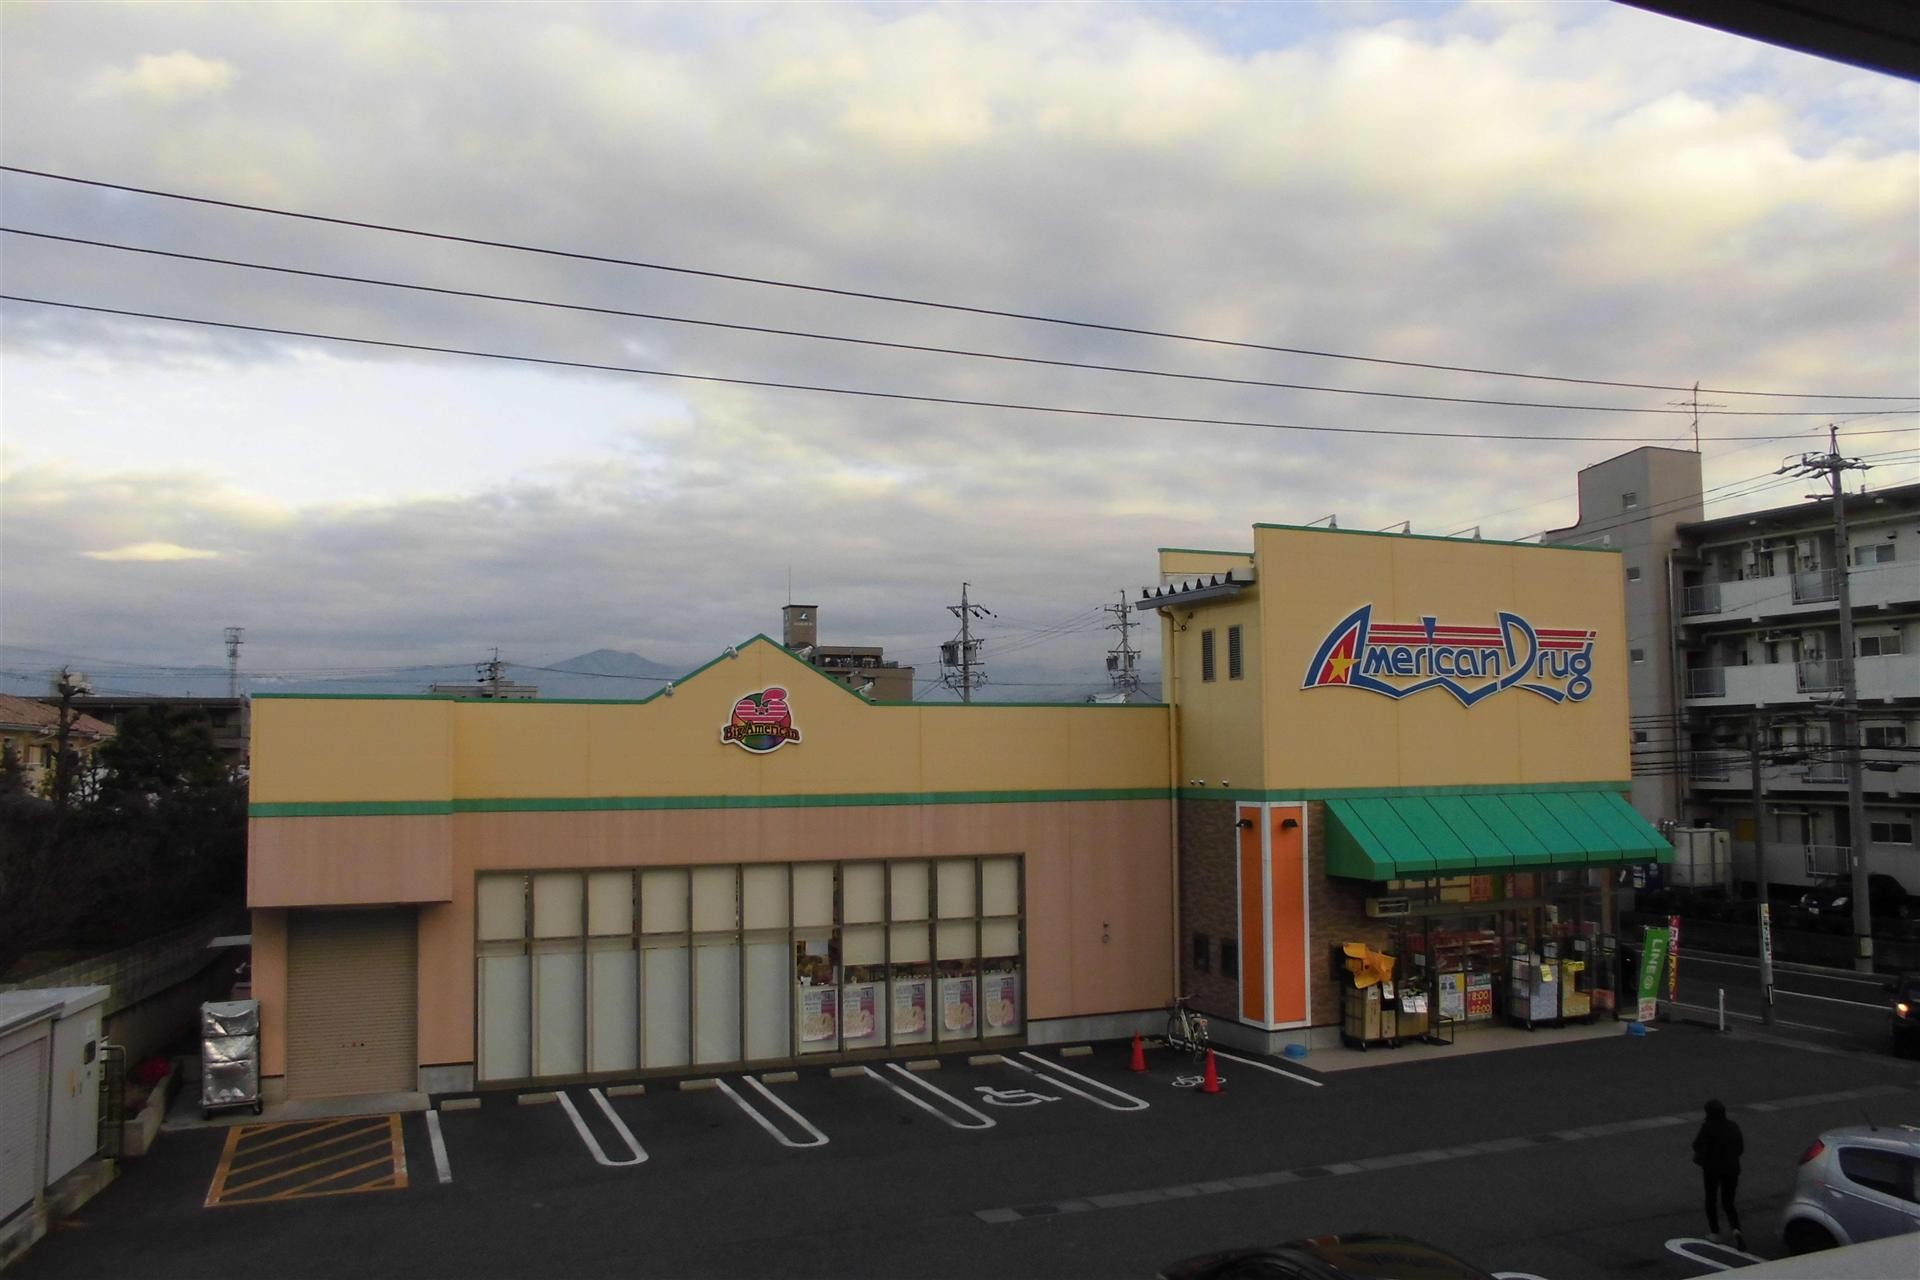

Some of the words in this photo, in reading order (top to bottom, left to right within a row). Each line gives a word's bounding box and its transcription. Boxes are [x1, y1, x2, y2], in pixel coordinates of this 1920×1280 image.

[1301, 602, 1500, 695] American
[1498, 609, 1595, 702] Drug
[723, 725, 744, 740] Big
[745, 721, 800, 740] American
